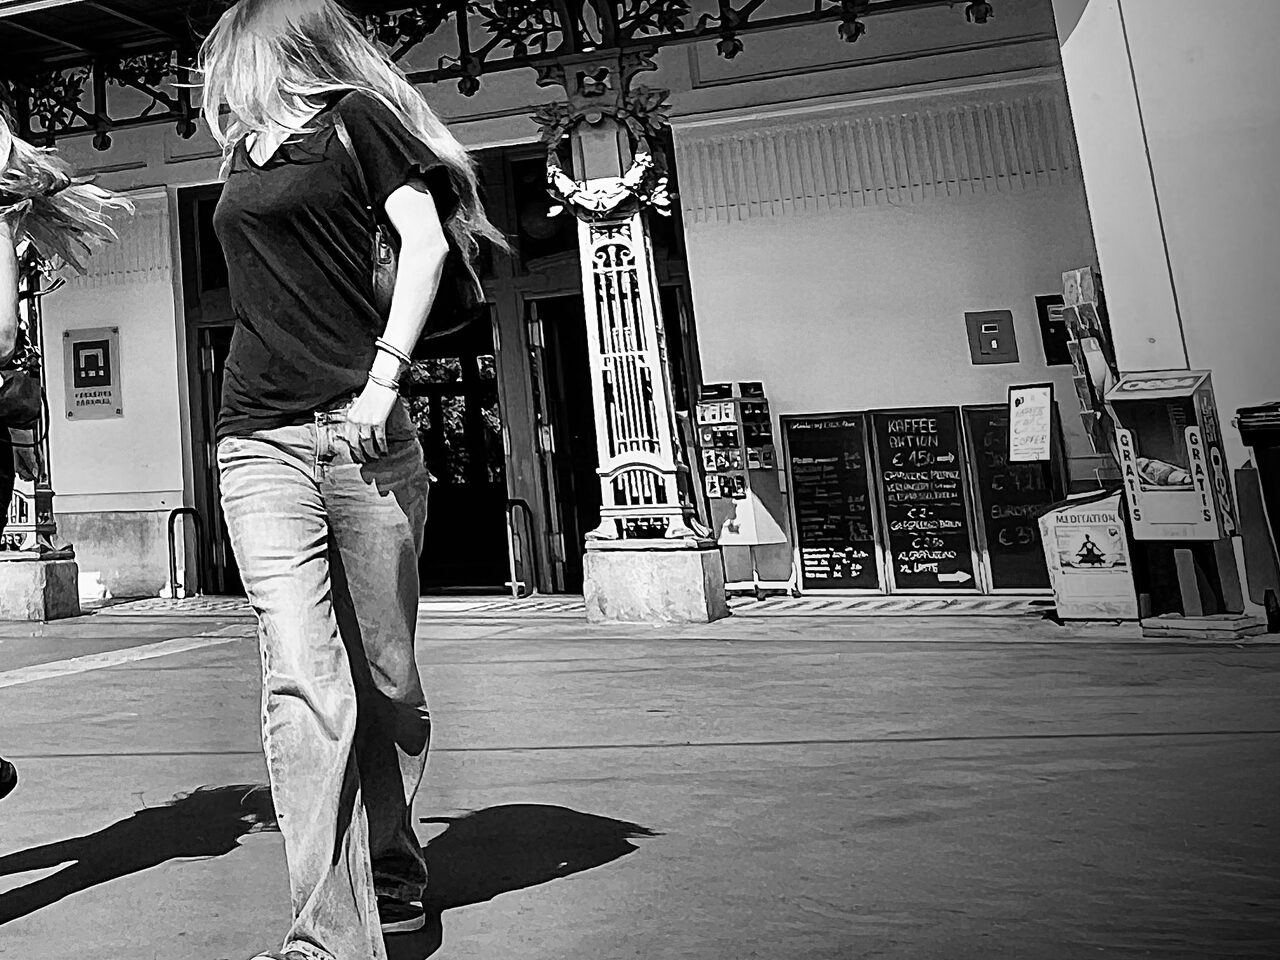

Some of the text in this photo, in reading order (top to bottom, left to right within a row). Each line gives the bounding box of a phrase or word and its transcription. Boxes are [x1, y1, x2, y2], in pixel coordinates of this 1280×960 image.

[888, 418, 938, 433] KAFFEE
[1120, 434, 1142, 522] GRATIS
[1189, 432, 1212, 522] GRATIS
